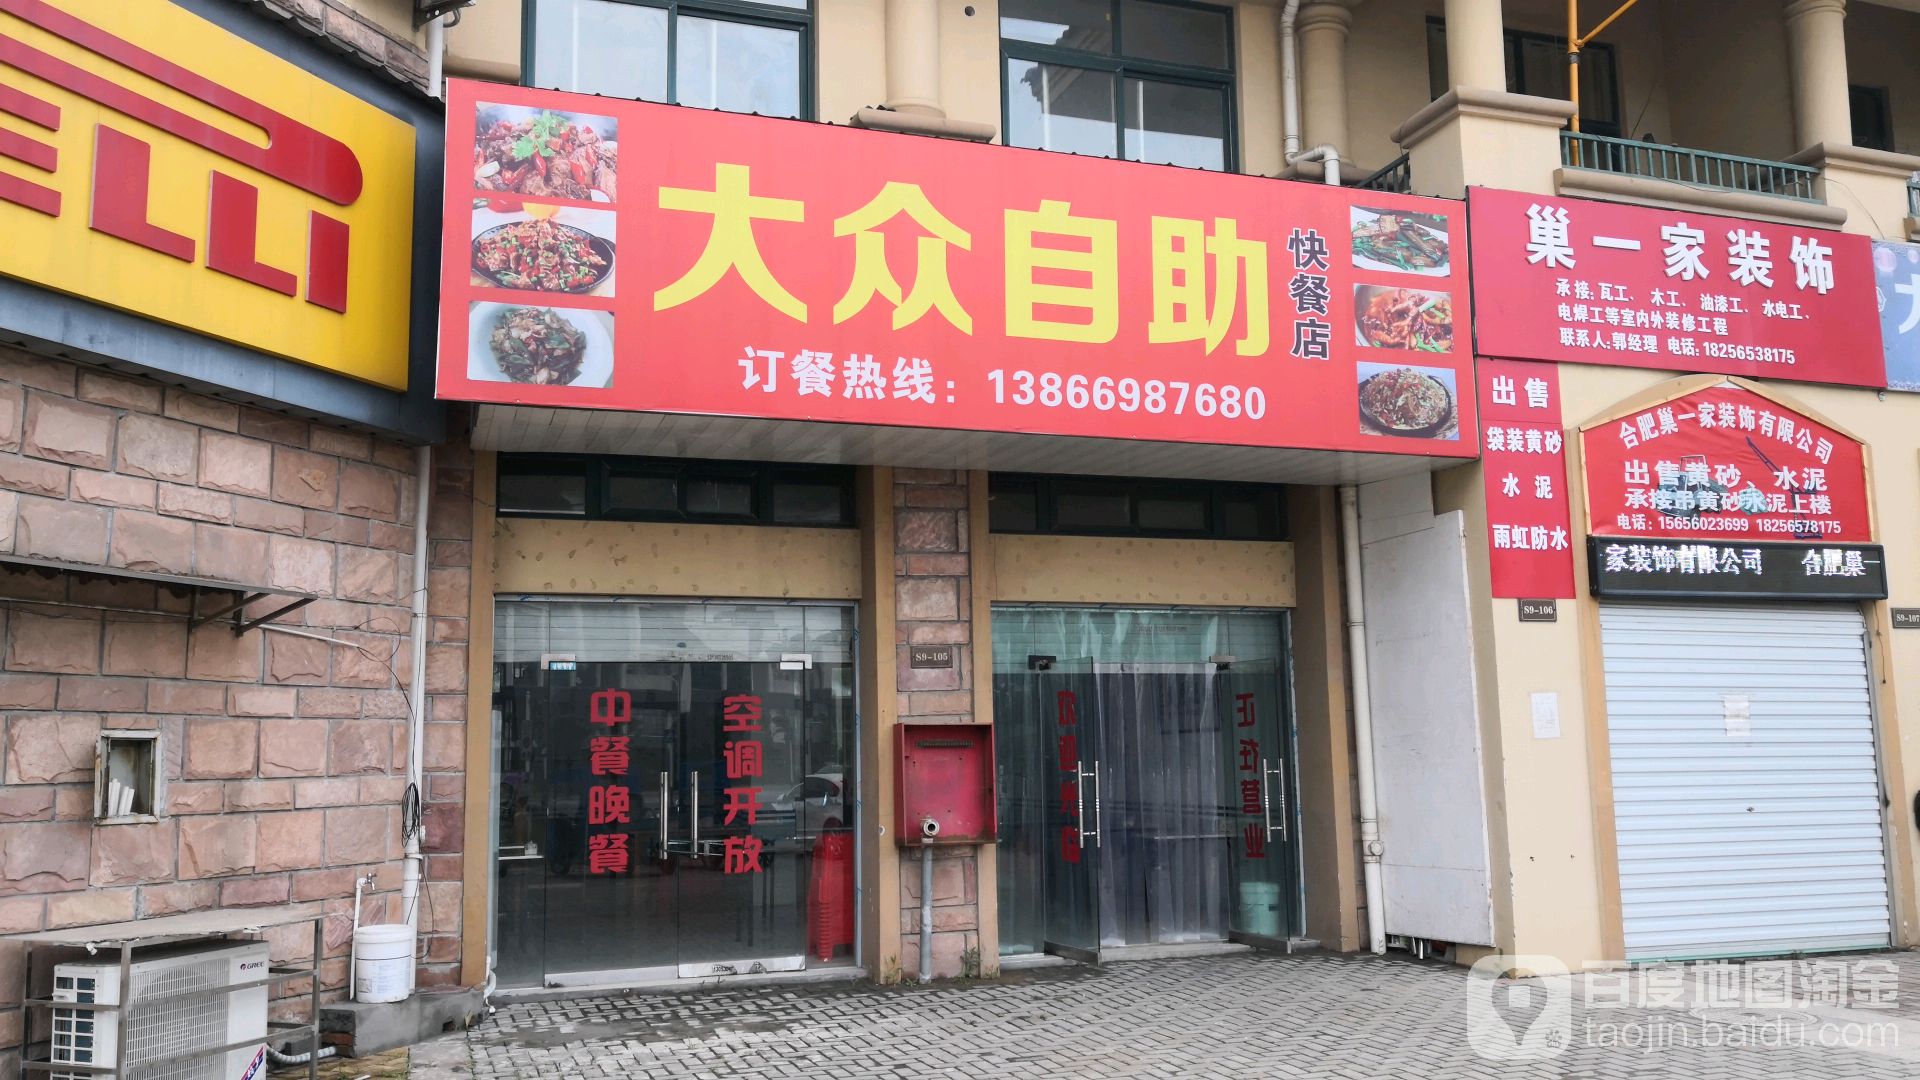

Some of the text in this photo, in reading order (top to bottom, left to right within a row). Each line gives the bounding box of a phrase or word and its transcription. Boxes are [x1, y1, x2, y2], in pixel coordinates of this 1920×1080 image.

[653, 162, 1270, 357] 大众自助
[1525, 203, 1834, 295] 巢一家装饰
[1286, 227, 1331, 361] 快餐店
[1557, 303, 1729, 336] 电焊工等室内外装修工程
[1492, 375, 1549, 408] 出售
[1486, 426, 1562, 455] 袋装黄砂
[1619, 401, 1834, 465] 合肥巢一家装饰有限公司
[1502, 472, 1553, 499] 水泥
[1492, 524, 1569, 551] 雨虹防水
[1756, 518, 1842, 534] 18256578175
[1523, 605, 1554, 615] S9-106
[915, 652, 949, 661] S9-105
[589, 688, 631, 874] 中餐晚餐
[723, 694, 763, 874] 空调开放
